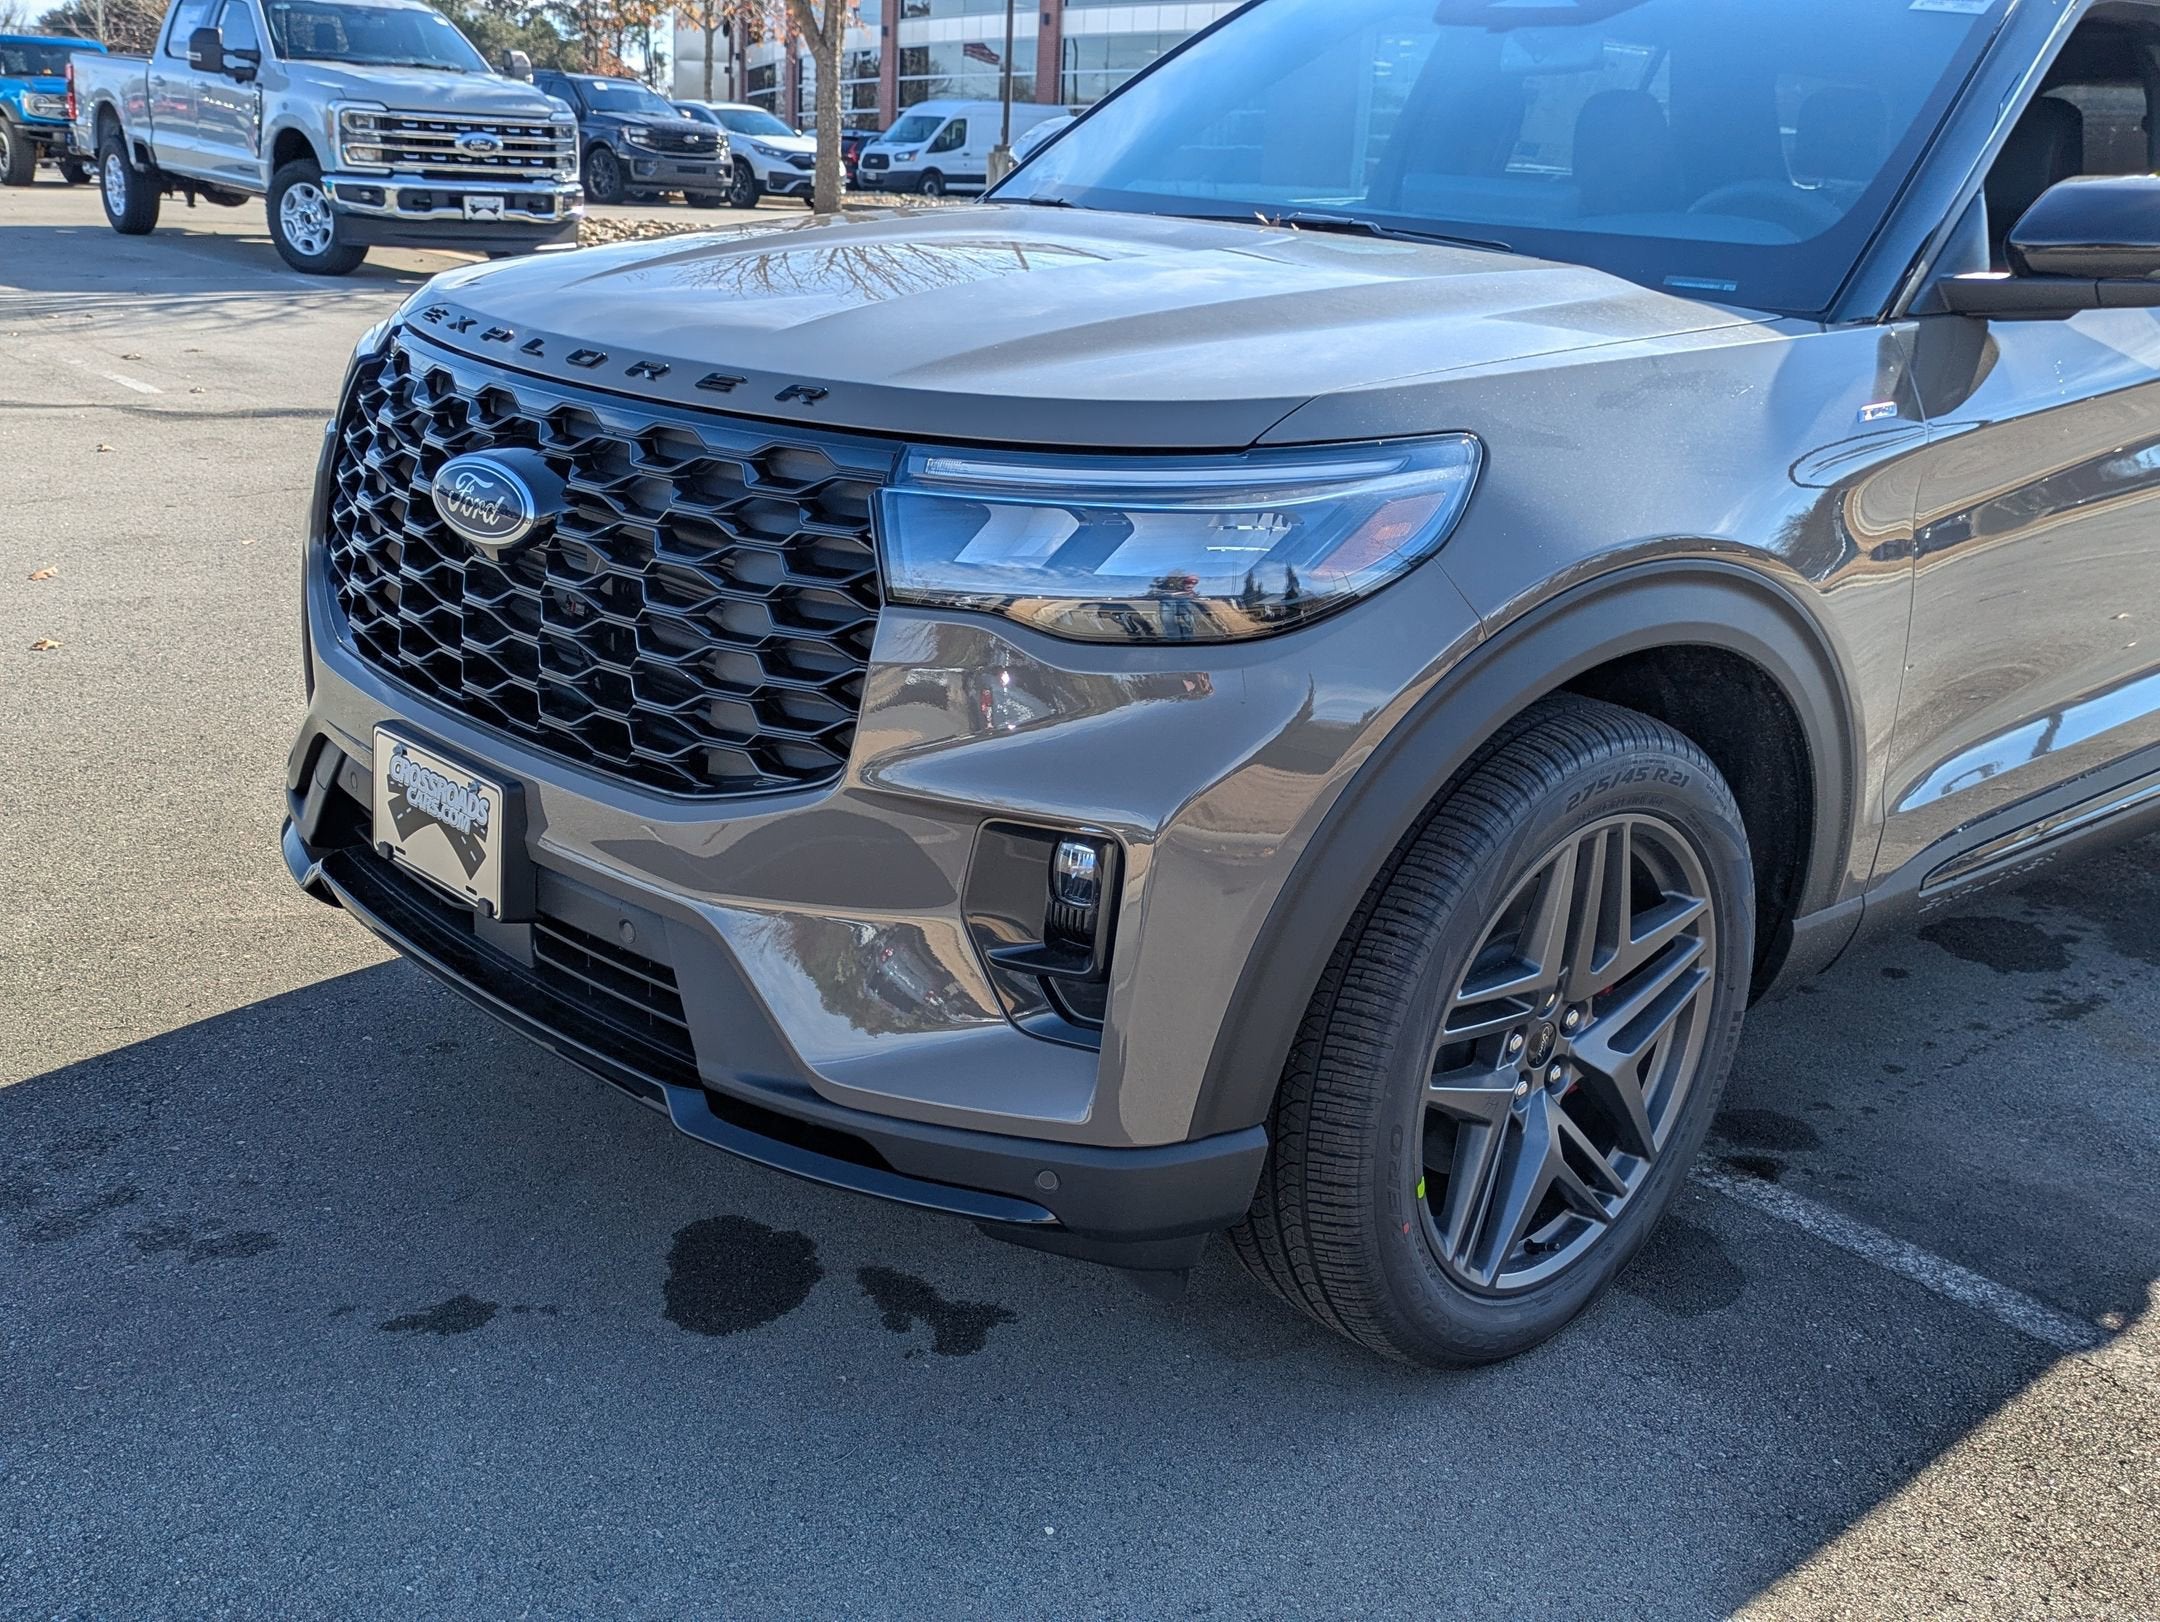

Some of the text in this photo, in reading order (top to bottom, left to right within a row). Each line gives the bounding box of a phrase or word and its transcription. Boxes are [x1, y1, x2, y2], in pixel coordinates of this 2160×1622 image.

[421, 304, 829, 406] EXPLORER
[447, 472, 505, 525] Ford
[389, 754, 490, 826] CROSSROADS
[406, 786, 471, 835] CARS.COM
[1565, 766, 1650, 815] 275/45
